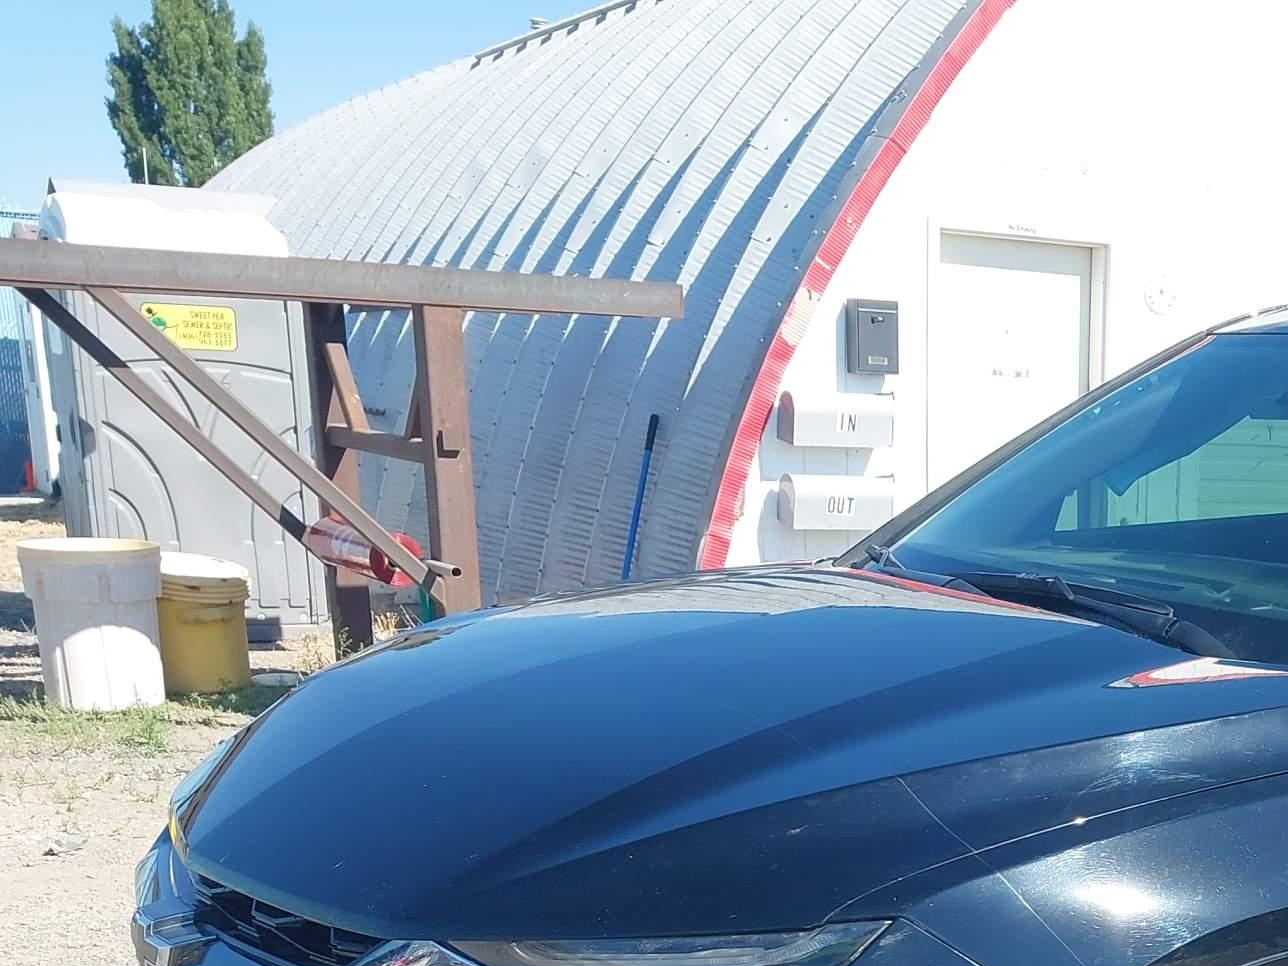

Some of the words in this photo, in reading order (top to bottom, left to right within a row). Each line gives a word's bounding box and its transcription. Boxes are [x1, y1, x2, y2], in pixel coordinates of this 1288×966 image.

[190, 311, 210, 319] SWEET
[212, 312, 224, 320] PEA
[183, 320, 205, 330] SEWER
[212, 322, 233, 331] SEPTIC
[840, 413, 857, 432] IN
[827, 496, 855, 514] OUT
